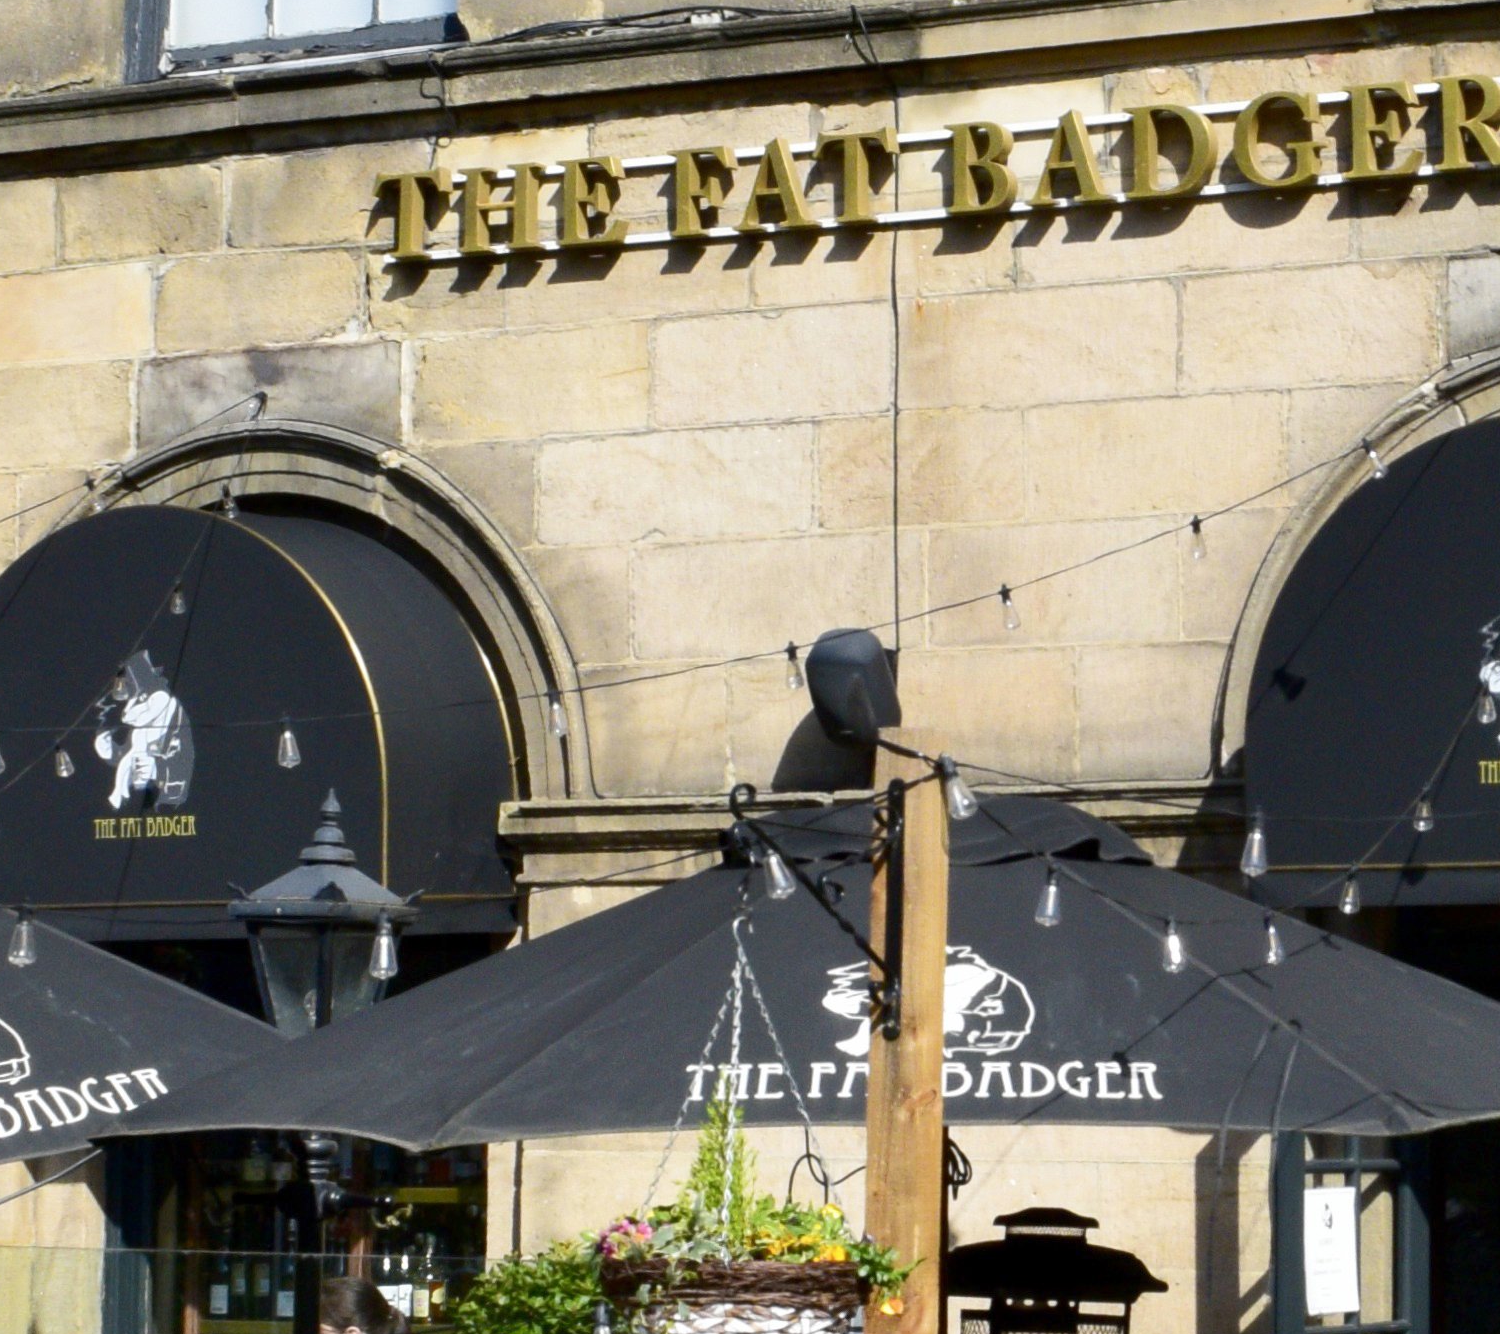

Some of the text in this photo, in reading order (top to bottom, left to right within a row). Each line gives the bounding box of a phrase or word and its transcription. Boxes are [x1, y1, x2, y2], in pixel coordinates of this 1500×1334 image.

[376, 155, 631, 260] THE
[668, 126, 898, 239] FAT
[93, 815, 197, 840] THE FAT BADGER
[686, 1063, 787, 1102] THE
[807, 1062, 869, 1099] FA
